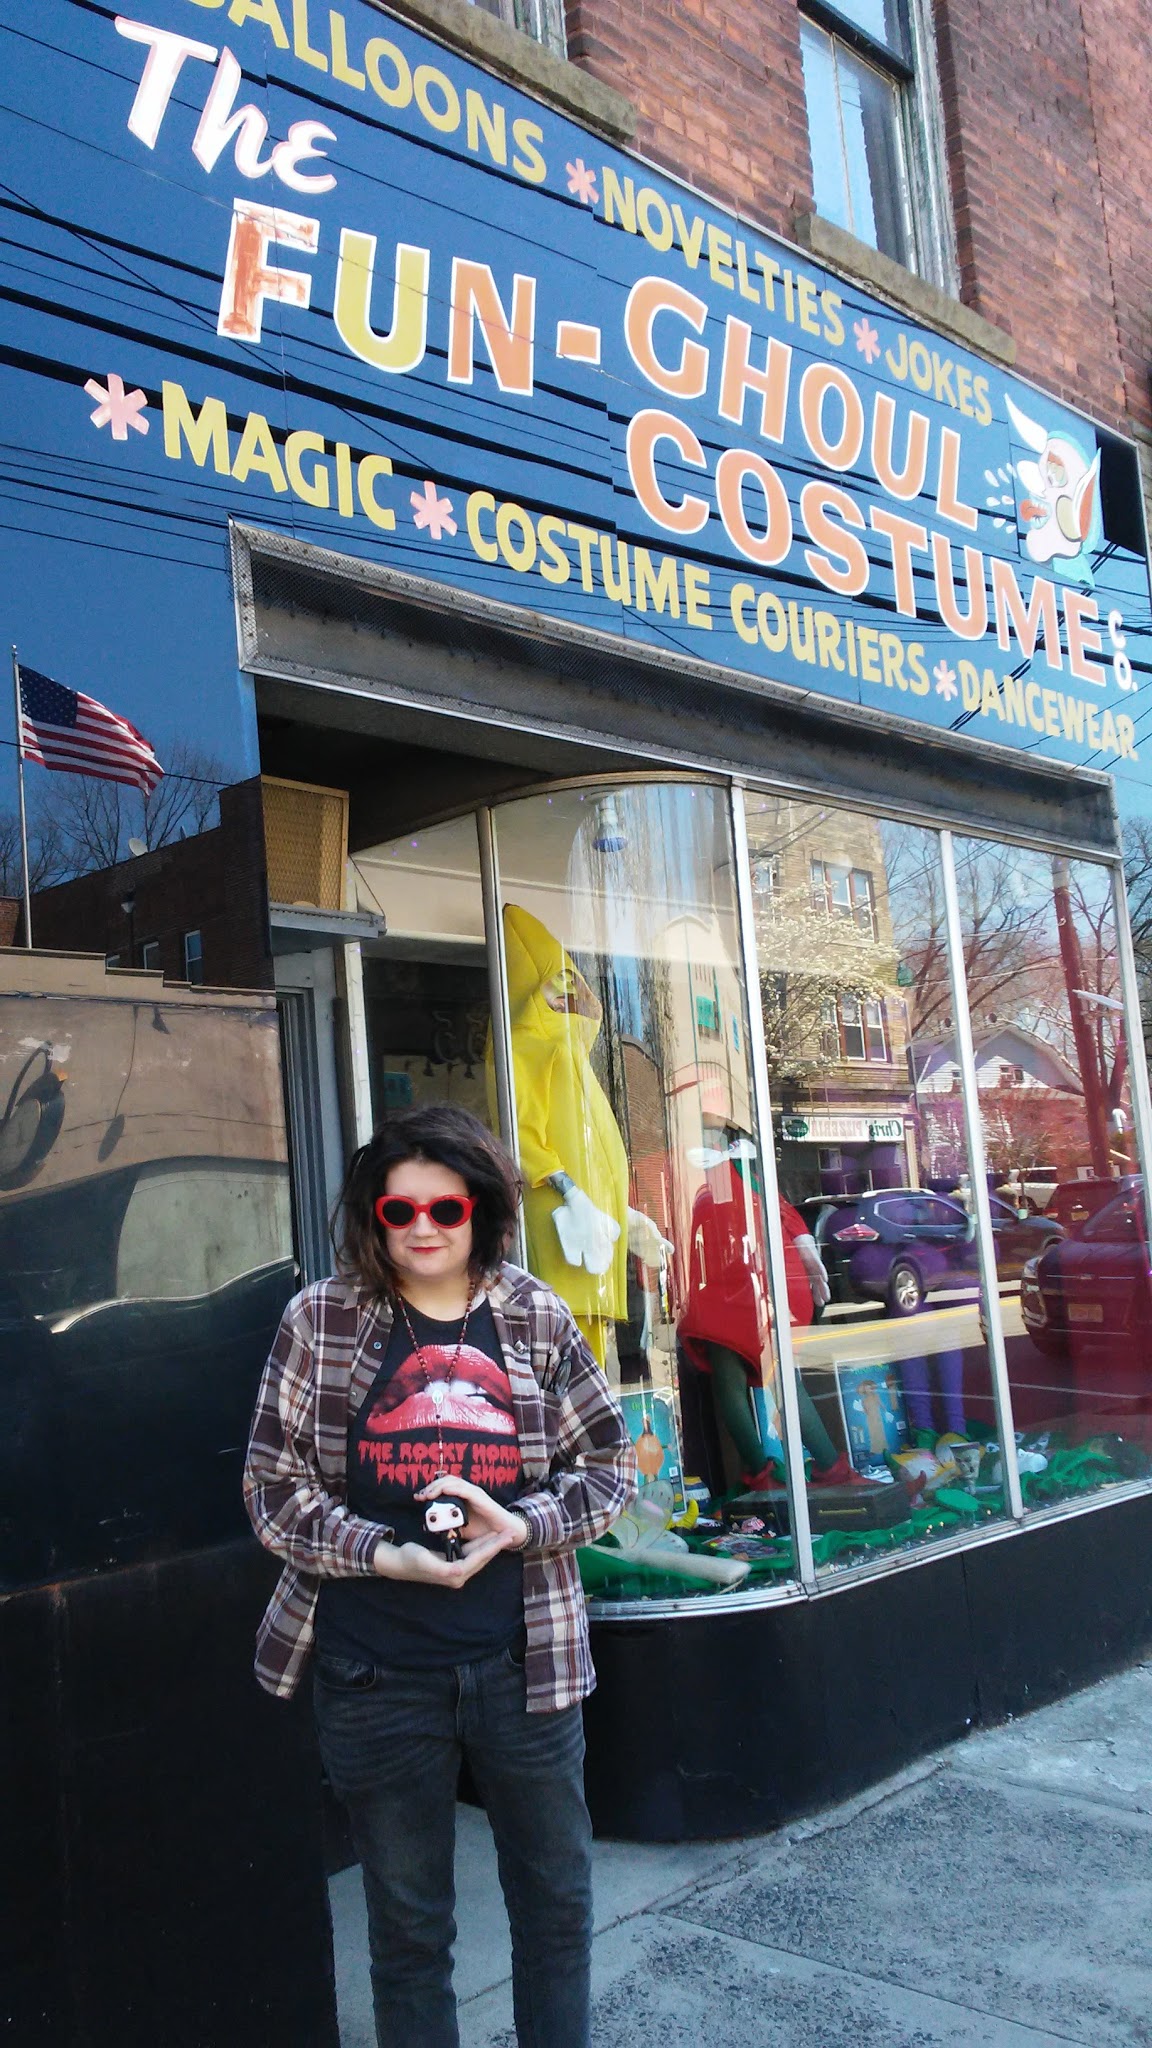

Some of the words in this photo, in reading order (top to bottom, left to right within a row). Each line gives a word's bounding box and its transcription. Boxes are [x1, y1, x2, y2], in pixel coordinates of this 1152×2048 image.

[115, 16, 337, 194] The
[191, 0, 547, 183] ALLOONS
[601, 166, 846, 347] NOVELTIES
[885, 333, 993, 427] JOKES
[161, 380, 396, 531] MAGIC
[466, 490, 713, 630] COSTUME
[730, 582, 931, 697] COURIERS
[958, 659, 1140, 761] DANCEWEAR
[626, 409, 1107, 688] COSTUME
[358, 1440, 393, 1464] THE
[399, 1442, 468, 1463] ROCKY
[472, 1443, 522, 1466] HORR
[470, 1464, 518, 1491] SHOW
